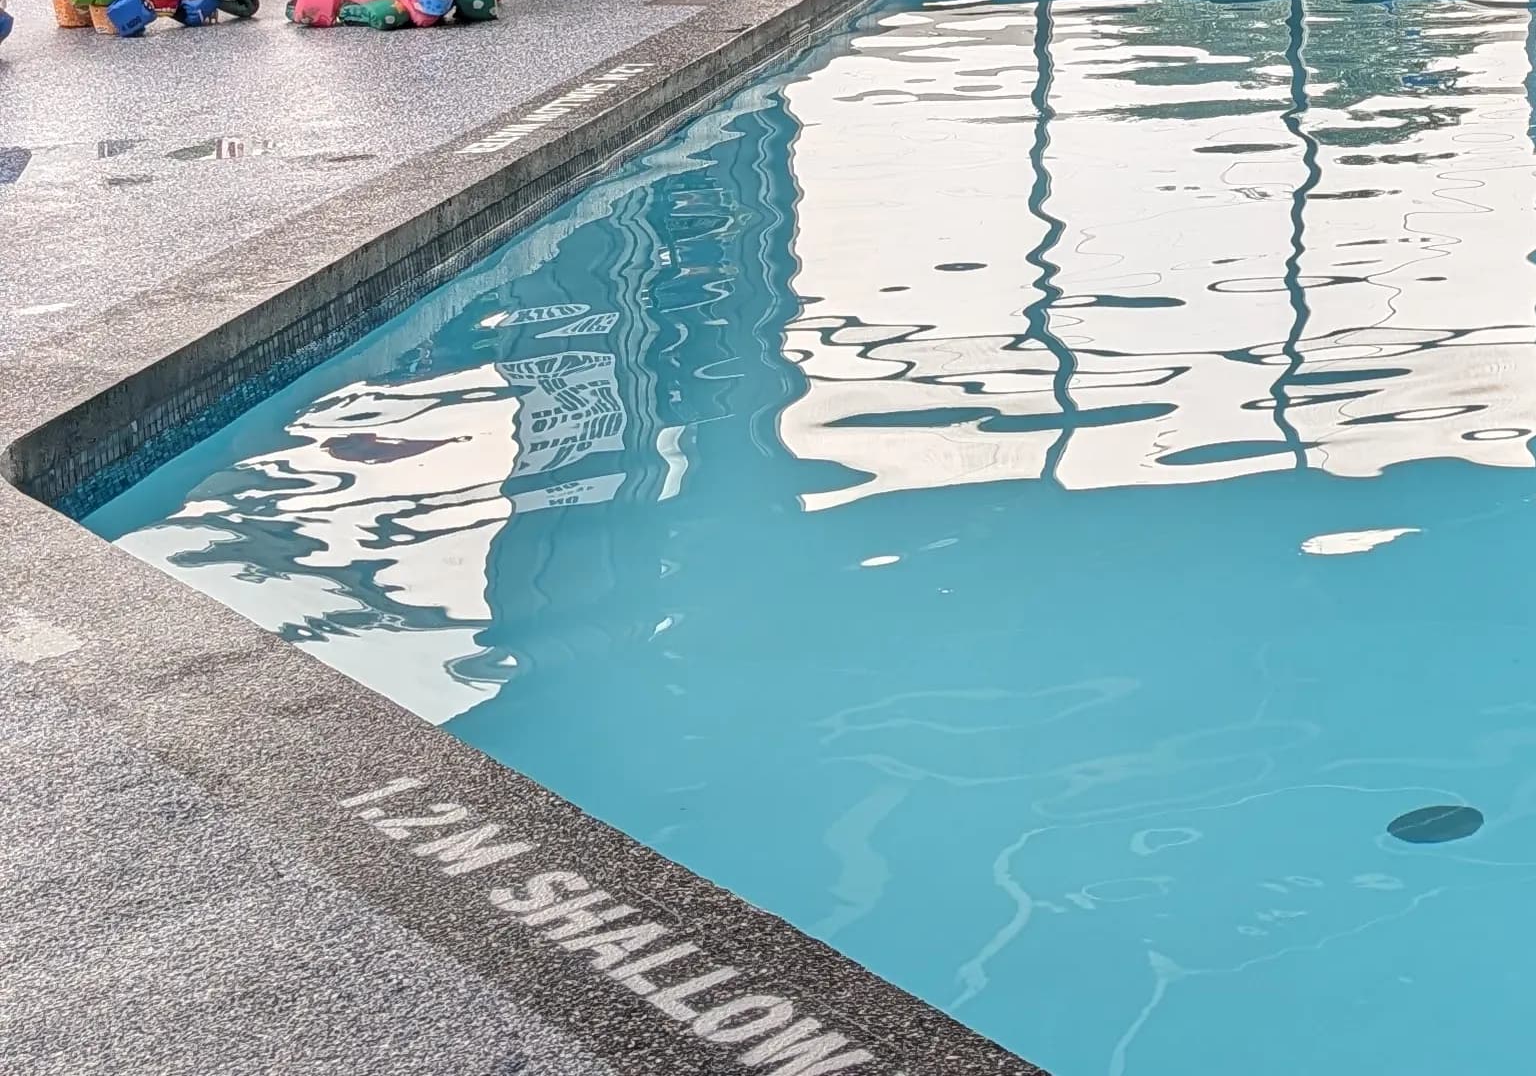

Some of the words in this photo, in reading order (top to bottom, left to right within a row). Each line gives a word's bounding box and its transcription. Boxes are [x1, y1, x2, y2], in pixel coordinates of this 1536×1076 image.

[522, 82, 617, 122] SHALLOW
[454, 123, 542, 154] WATER
[338, 777, 539, 877] 1.2M
[489, 870, 876, 1076] SHALLOW
